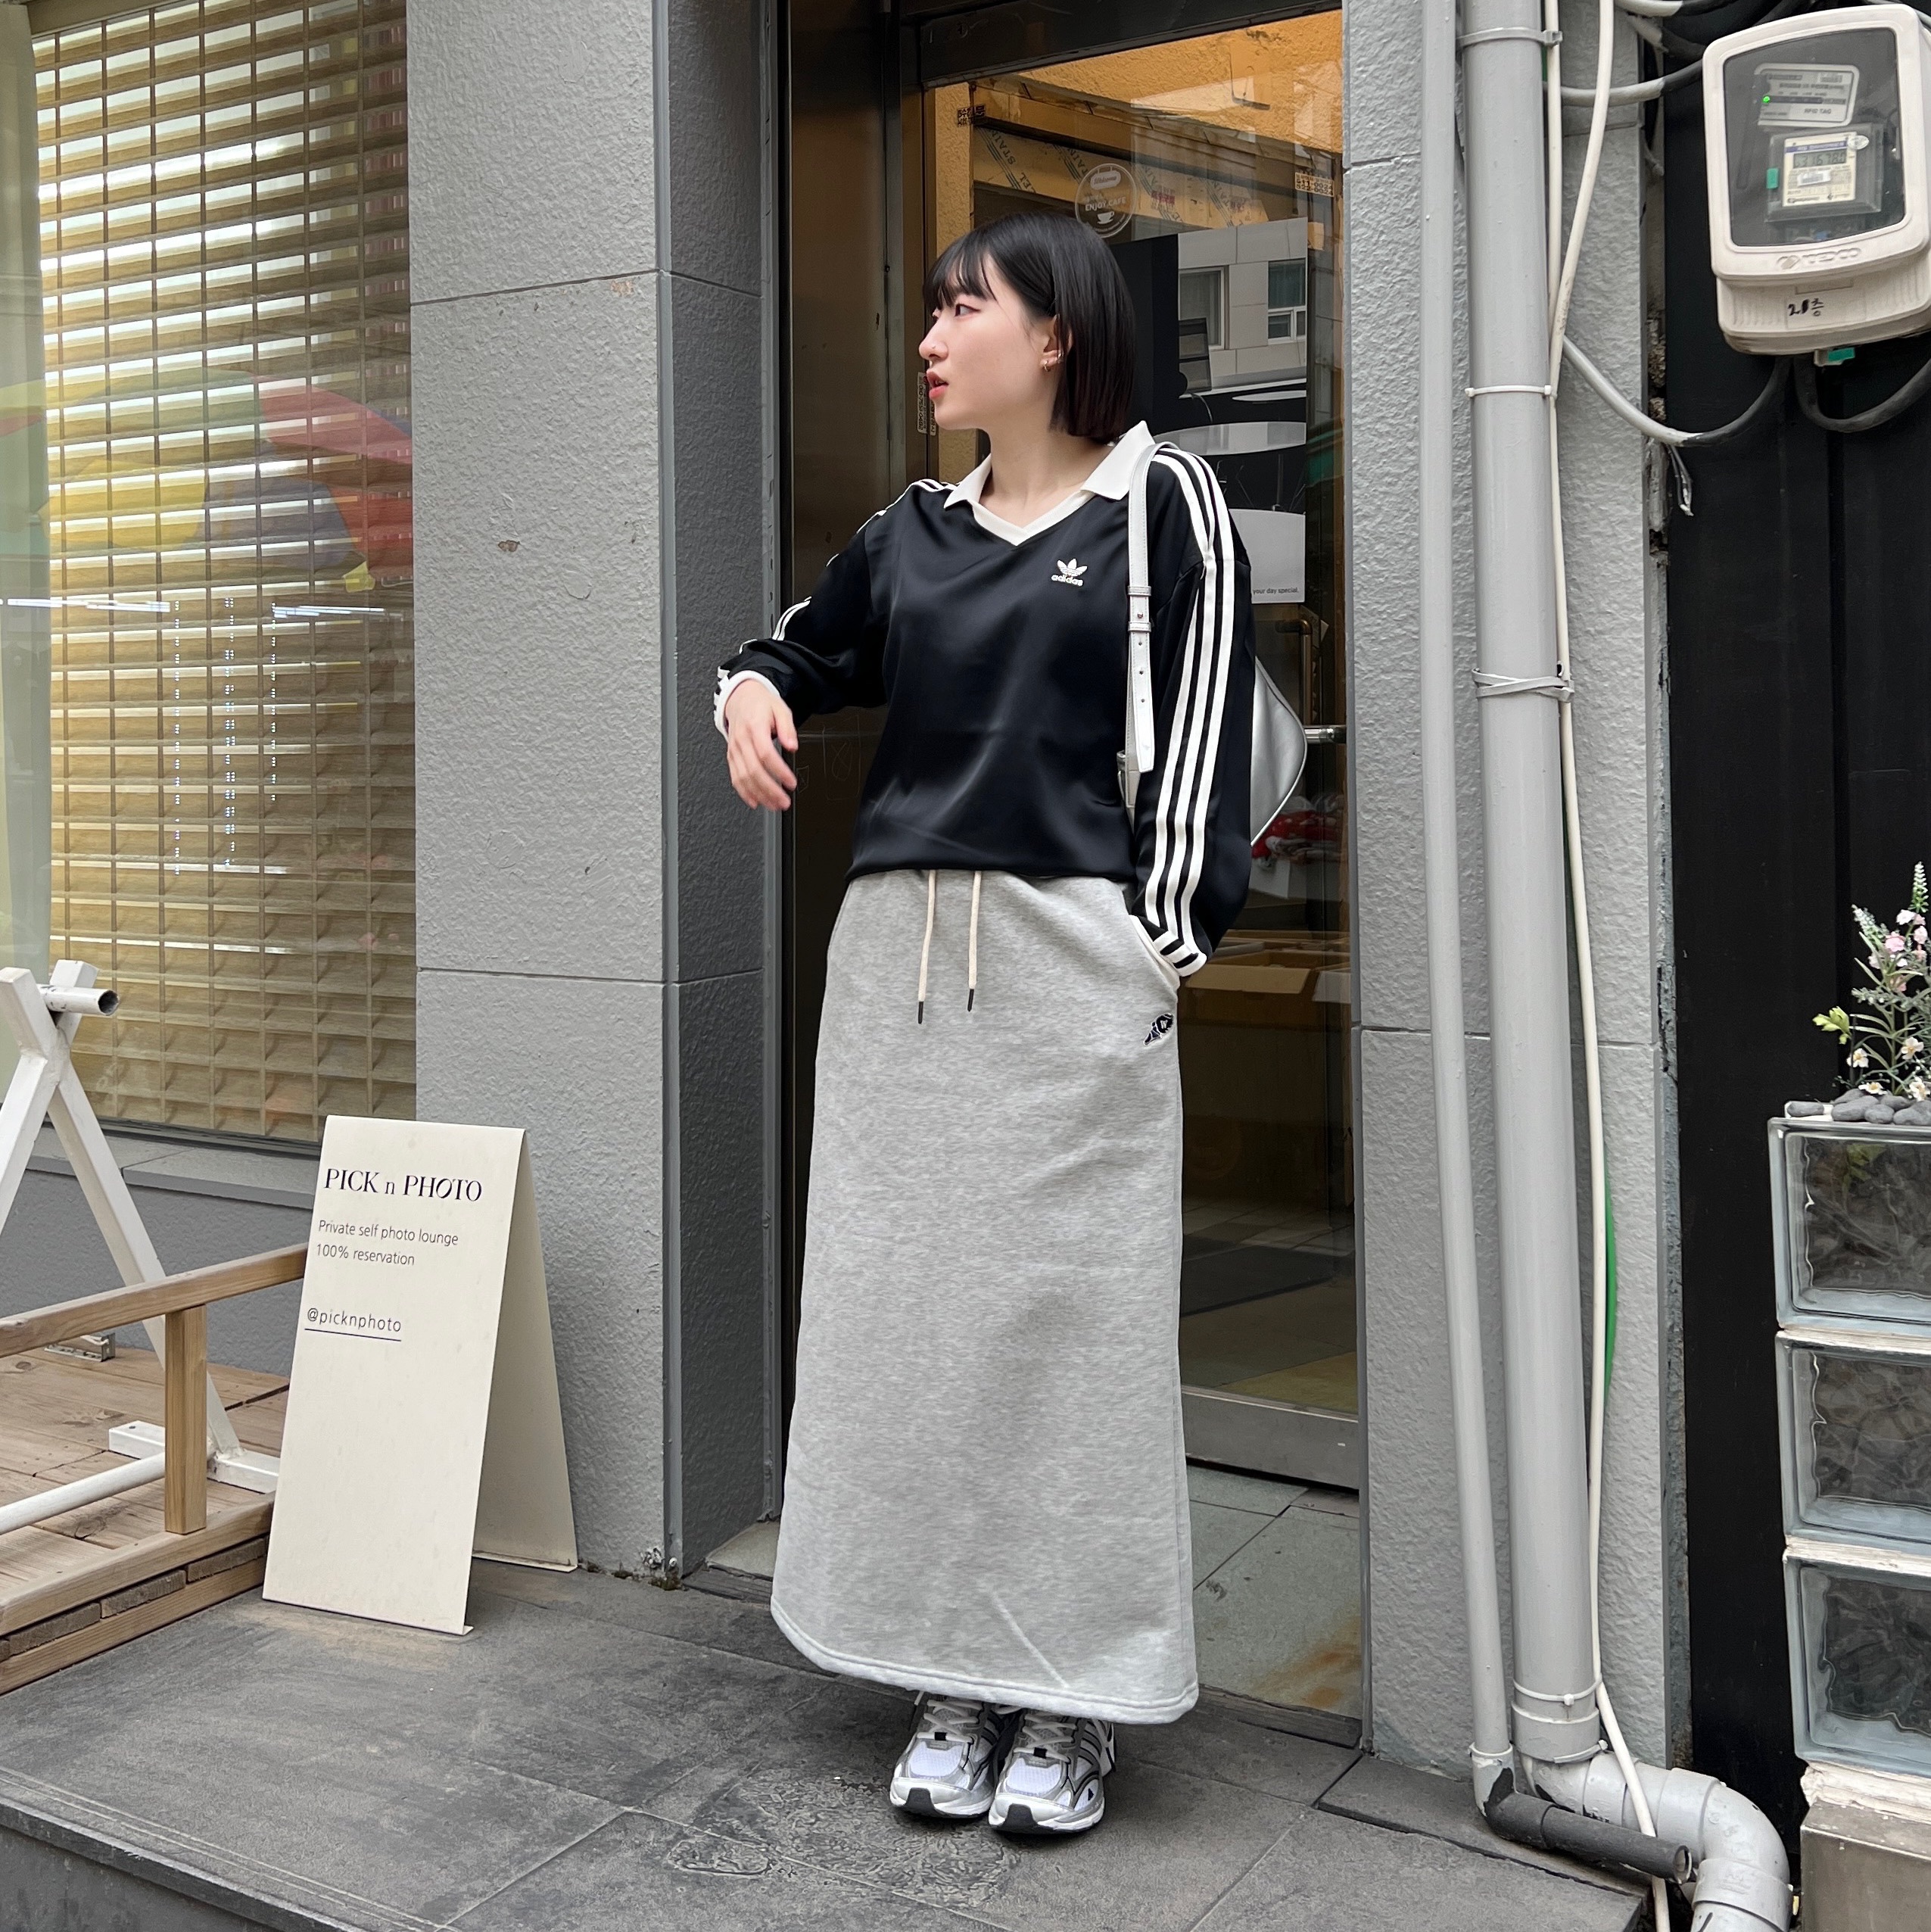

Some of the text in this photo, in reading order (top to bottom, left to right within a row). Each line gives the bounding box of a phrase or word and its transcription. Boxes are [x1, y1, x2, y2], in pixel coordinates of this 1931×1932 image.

[1085, 197, 1127, 211] ENJOY CAFE
[1051, 575, 1083, 587] adidas
[324, 1168, 482, 1202] PICK n PHOTO
[318, 1220, 459, 1247] Private self photo lounge
[316, 1244, 415, 1266] 100% reservation
[307, 1307, 401, 1332] @picknphoto
